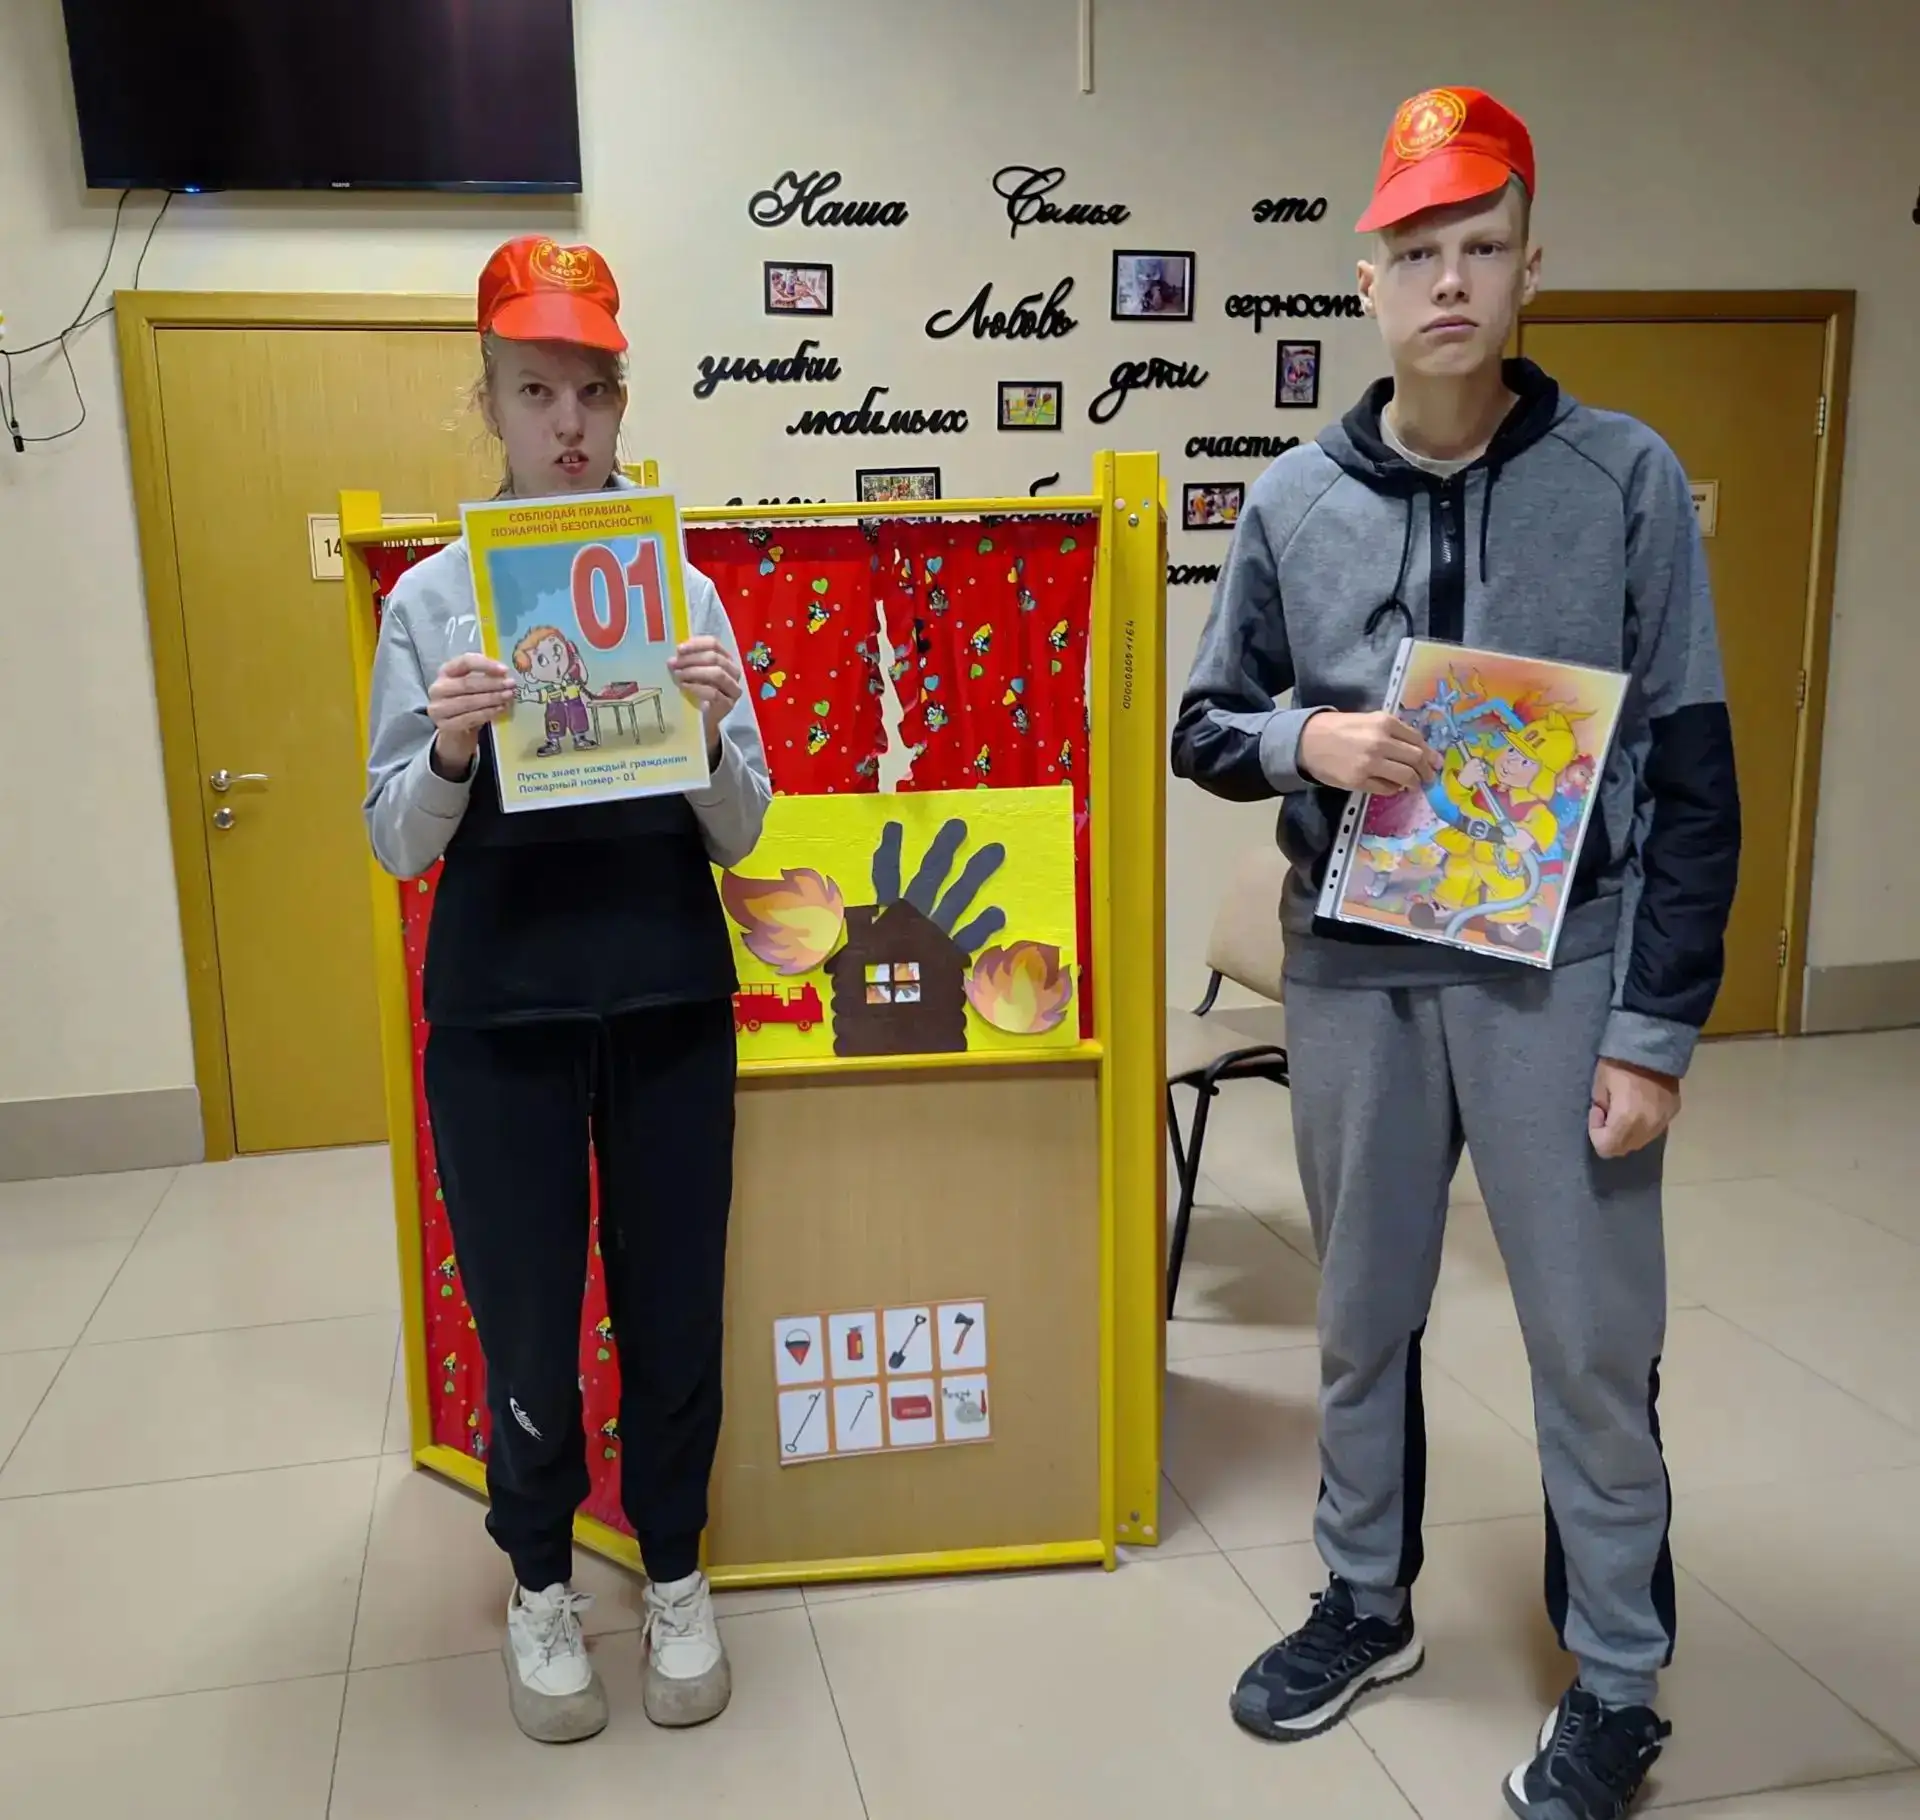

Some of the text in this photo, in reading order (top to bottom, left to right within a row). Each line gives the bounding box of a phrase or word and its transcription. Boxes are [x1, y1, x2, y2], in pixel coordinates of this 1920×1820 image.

[749, 170, 909, 228] Наша
[992, 165, 1130, 239] Семья
[1252, 197, 1327, 223] это
[925, 276, 1078, 339] Любовь
[693, 340, 842, 398] улыбки
[1088, 357, 1208, 424] дети
[786, 386, 969, 435] любимых
[491, 520, 558, 537] ПОЖАРНОЙ
[509, 504, 632, 522] СОБЛЮДАЙ ПРАВИЛА
[571, 539, 668, 651] 01
[517, 755, 688, 782] Пусть знает каждый гражданин
[519, 781, 578, 794] Пожарный
[580, 776, 614, 788] номер
[623, 773, 636, 782] 01
